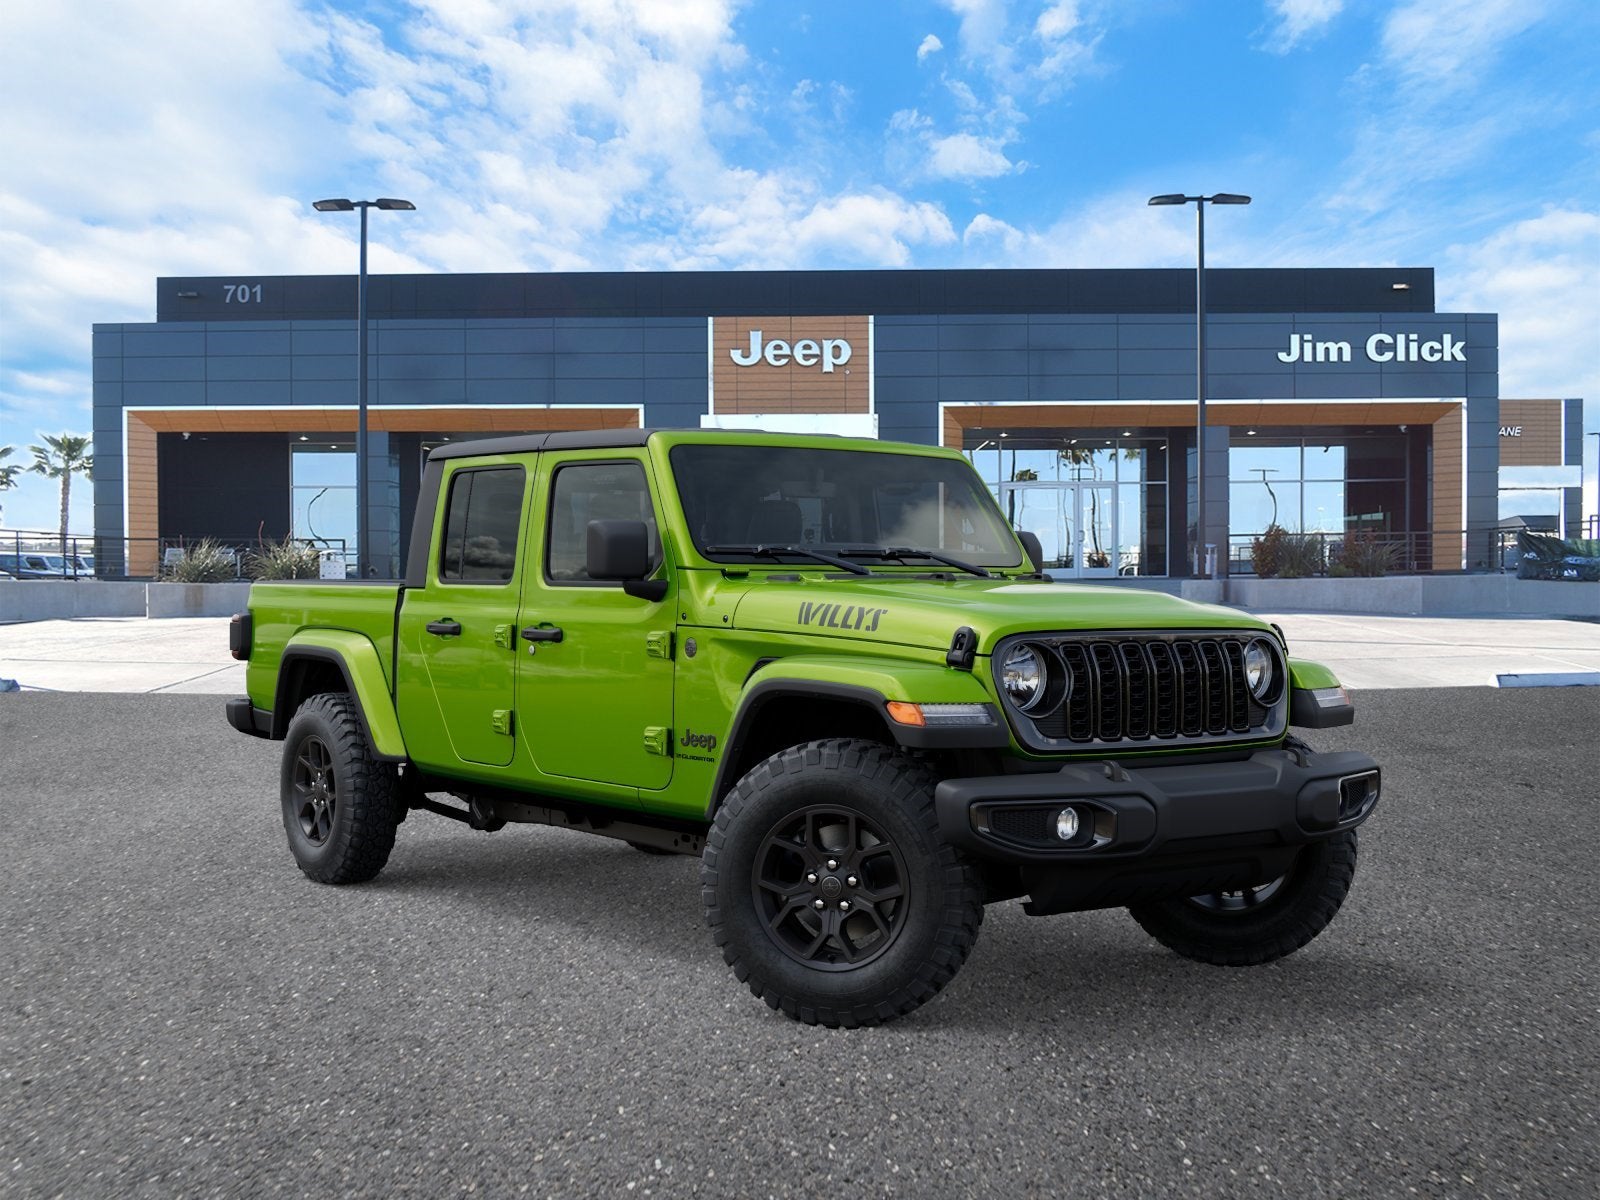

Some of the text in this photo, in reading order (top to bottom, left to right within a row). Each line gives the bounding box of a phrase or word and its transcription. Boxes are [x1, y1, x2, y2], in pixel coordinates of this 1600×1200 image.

[224, 284, 262, 304] 701
[730, 330, 852, 373] Jeep
[1277, 333, 1467, 363] Jim Click
[797, 601, 888, 632] WILLYS
[680, 728, 717, 752] Jeep
